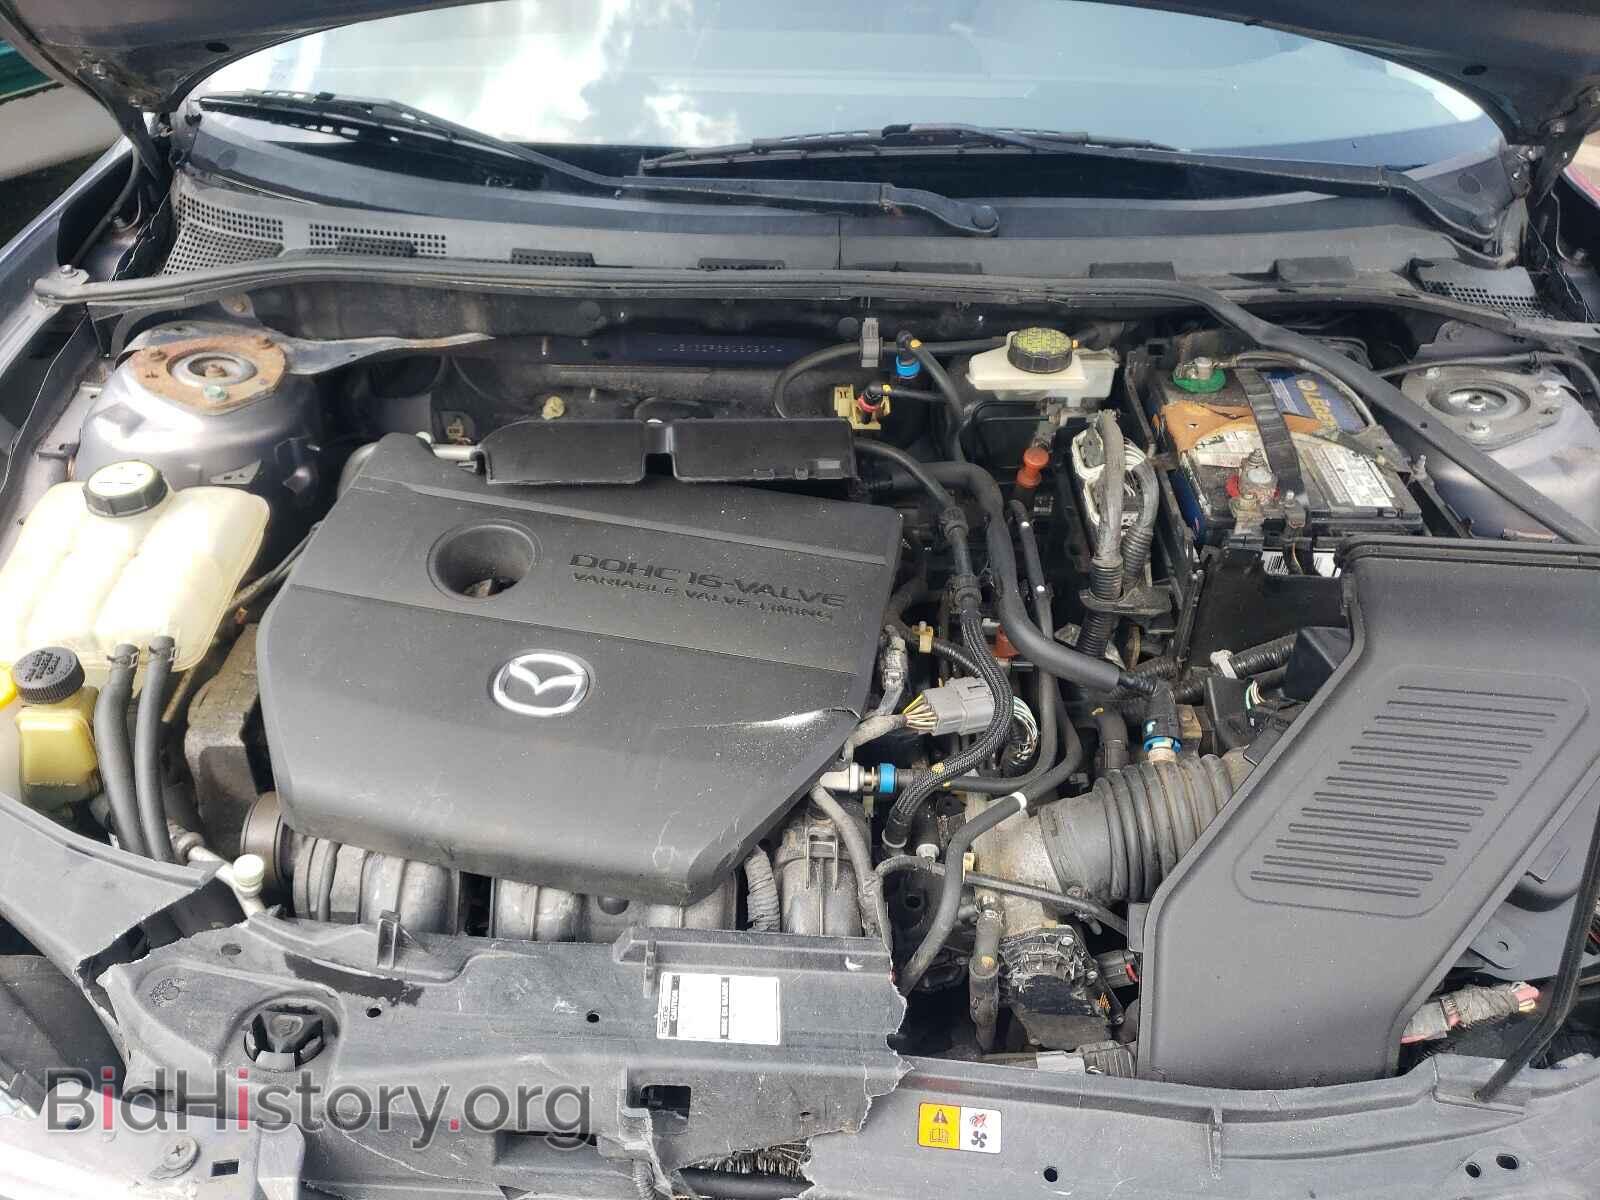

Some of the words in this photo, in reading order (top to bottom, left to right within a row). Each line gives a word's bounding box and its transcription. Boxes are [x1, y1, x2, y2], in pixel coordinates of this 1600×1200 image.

[568, 553, 682, 581] DOHC
[687, 571, 847, 608] 16-VALVE
[685, 588, 747, 606] VALVE
